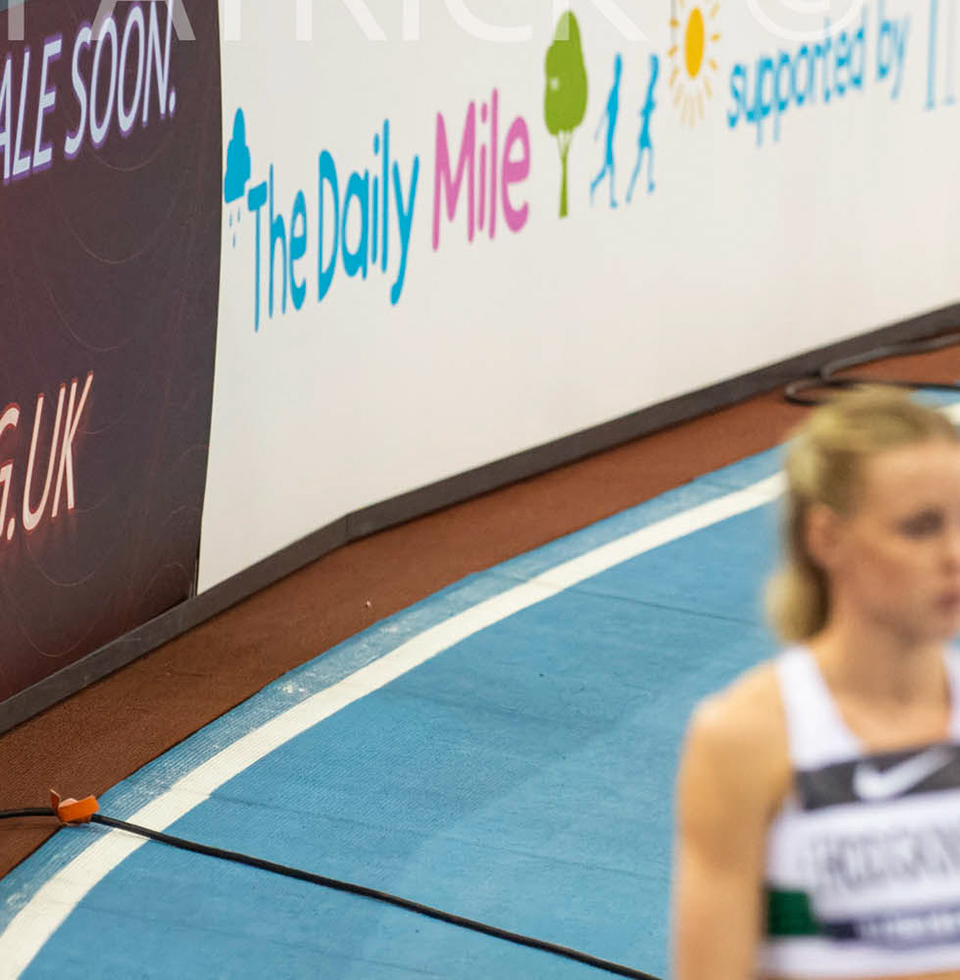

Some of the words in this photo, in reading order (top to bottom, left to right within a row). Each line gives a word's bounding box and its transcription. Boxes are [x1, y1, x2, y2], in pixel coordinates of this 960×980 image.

[727, 5, 868, 147] supported
[247, 163, 307, 333] The
[317, 118, 419, 306] Daily
[432, 87, 530, 252] Mile
